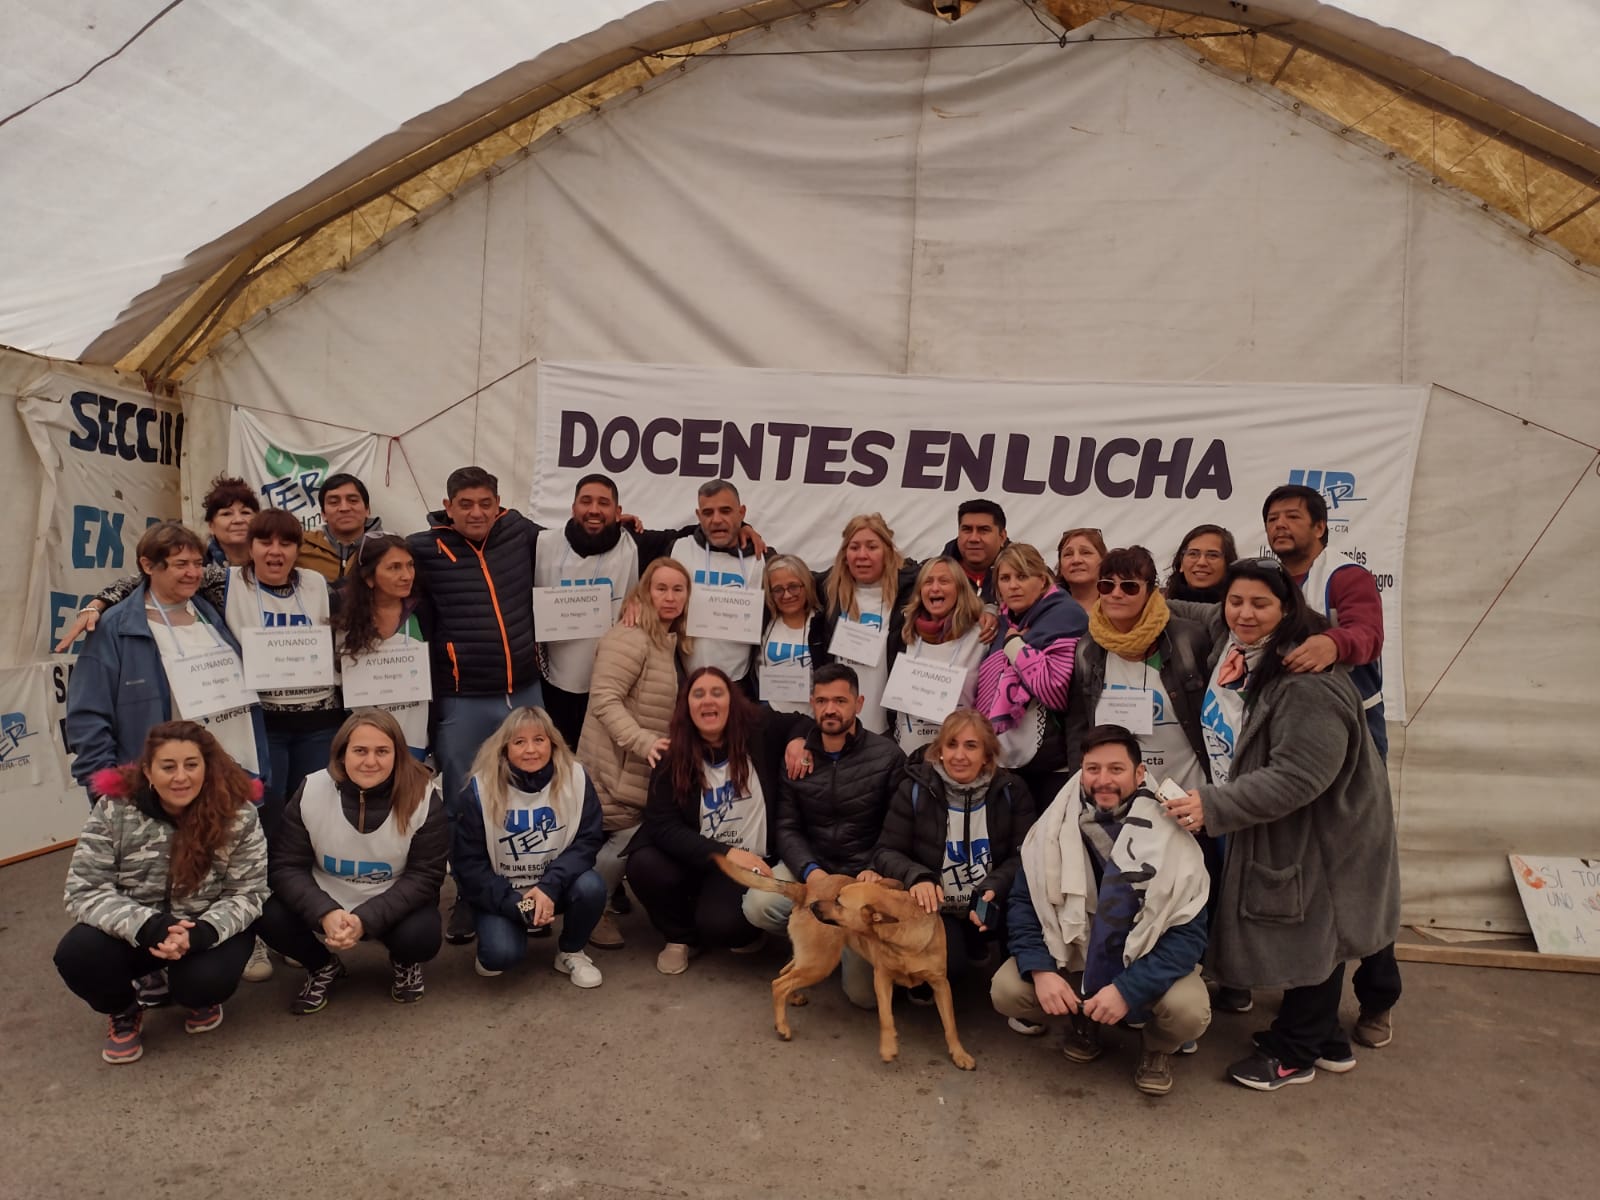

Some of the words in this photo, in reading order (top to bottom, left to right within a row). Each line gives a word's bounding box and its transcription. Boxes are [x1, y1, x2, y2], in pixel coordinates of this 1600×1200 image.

[558, 410, 895, 487] DOCENTES
[901, 430, 995, 493] EN
[1002, 433, 1233, 500] LUCHA
[554, 595, 598, 605] AYUNANDO
[709, 595, 751, 606] AYUNANDO
[267, 638, 317, 648] AYUNANDO
[190, 657, 234, 673] AYUNANDO
[366, 655, 414, 666] AYUNANDO
[911, 668, 951, 684] AYUNANDO
[504, 806, 557, 833] UP
[512, 864, 526, 872] UNA
